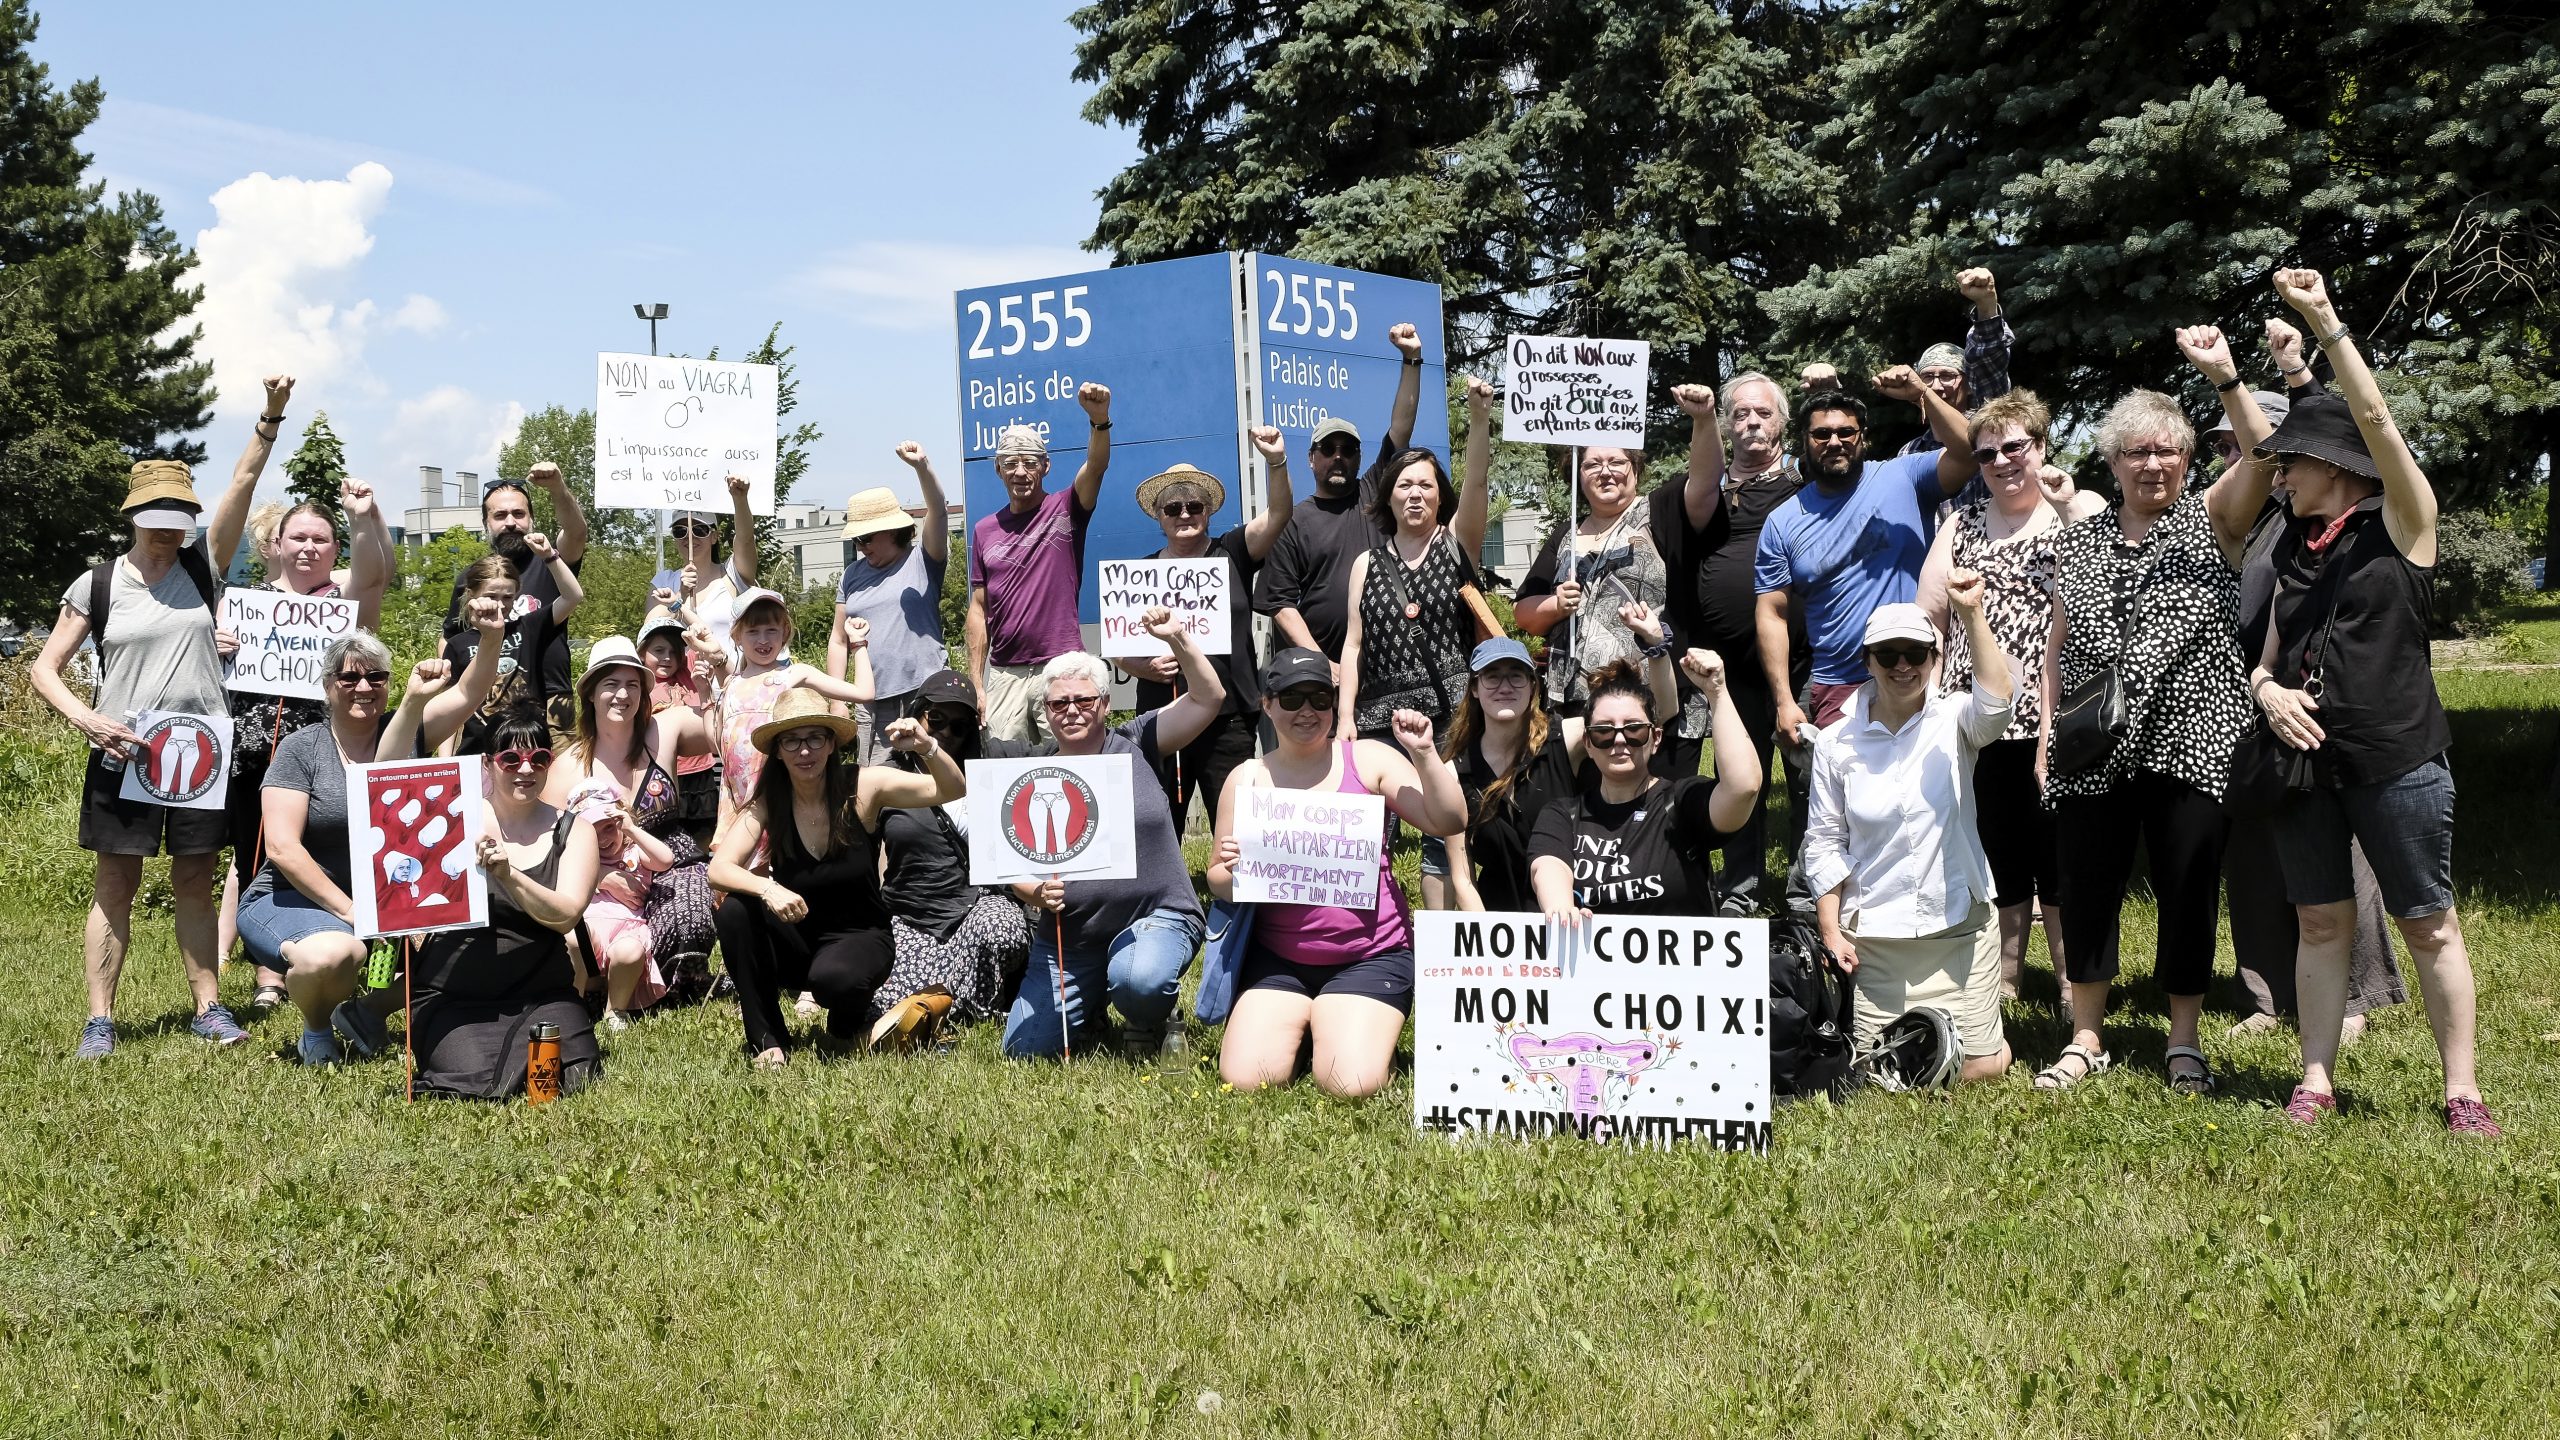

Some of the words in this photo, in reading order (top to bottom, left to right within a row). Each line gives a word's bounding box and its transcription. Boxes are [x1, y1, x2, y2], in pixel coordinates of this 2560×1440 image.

[1267, 269, 1358, 341] 2555
[967, 285, 1092, 360] 2555
[1513, 338, 1542, 367] On
[1546, 344, 1568, 365] dit
[1574, 342, 1605, 366] NON
[1606, 351, 1638, 366] aux
[606, 361, 647, 390] NON
[658, 379, 675, 390] au
[683, 366, 752, 399] VIAGRA
[1270, 352, 1322, 388] Palais
[1327, 359, 1349, 390] de
[1518, 370, 1602, 395] grossesses
[970, 374, 1036, 410] Palais
[1044, 369, 1073, 401] de
[1511, 391, 1535, 414] On
[1540, 393, 1562, 411] dit
[1610, 402, 1639, 416] aux
[1523, 411, 1591, 435] enfants
[608, 438, 709, 463] L'impuissance
[725, 449, 760, 461] aussi
[611, 467, 632, 481] est
[642, 467, 653, 482] la
[662, 466, 710, 481] volonté
[664, 489, 702, 503] Dieu
[1104, 563, 1158, 587] Mon
[229, 598, 264, 620] Mon
[273, 600, 349, 633] CORPS
[223, 654, 256, 680] Mon
[157, 717, 180, 731] corps
[181, 718, 218, 754] m'appartient
[138, 763, 154, 791] Touche
[152, 787, 168, 799] pas
[176, 792, 194, 800] mes
[194, 768, 218, 795] ovaires!
[380, 773, 408, 782] retourne
[410, 772, 422, 780] pas
[1006, 786, 1020, 806] Mon
[1019, 769, 1041, 787] corps
[1043, 767, 1091, 803] m'appartient
[1304, 805, 1364, 835] CORPS
[1007, 824, 1029, 855] Touche
[1029, 851, 1046, 860] pas
[1047, 852, 1053, 861] à
[1054, 849, 1074, 861] mes
[1073, 819, 1095, 852] ovaires!
[1239, 860, 1365, 887] L'AVORTEMENT
[1268, 882, 1305, 900] EST
[1309, 886, 1326, 903] UN
[1334, 889, 1376, 907] DROIT
[1454, 922, 1547, 960] MON
[1594, 926, 1744, 968] CORPS
[1461, 965, 1493, 977] MOI
[1520, 964, 1561, 978] BOSS
[1454, 987, 1549, 1025] MON
[1594, 992, 1764, 1036] CHOIX!
[1539, 1057, 1556, 1067] EN
